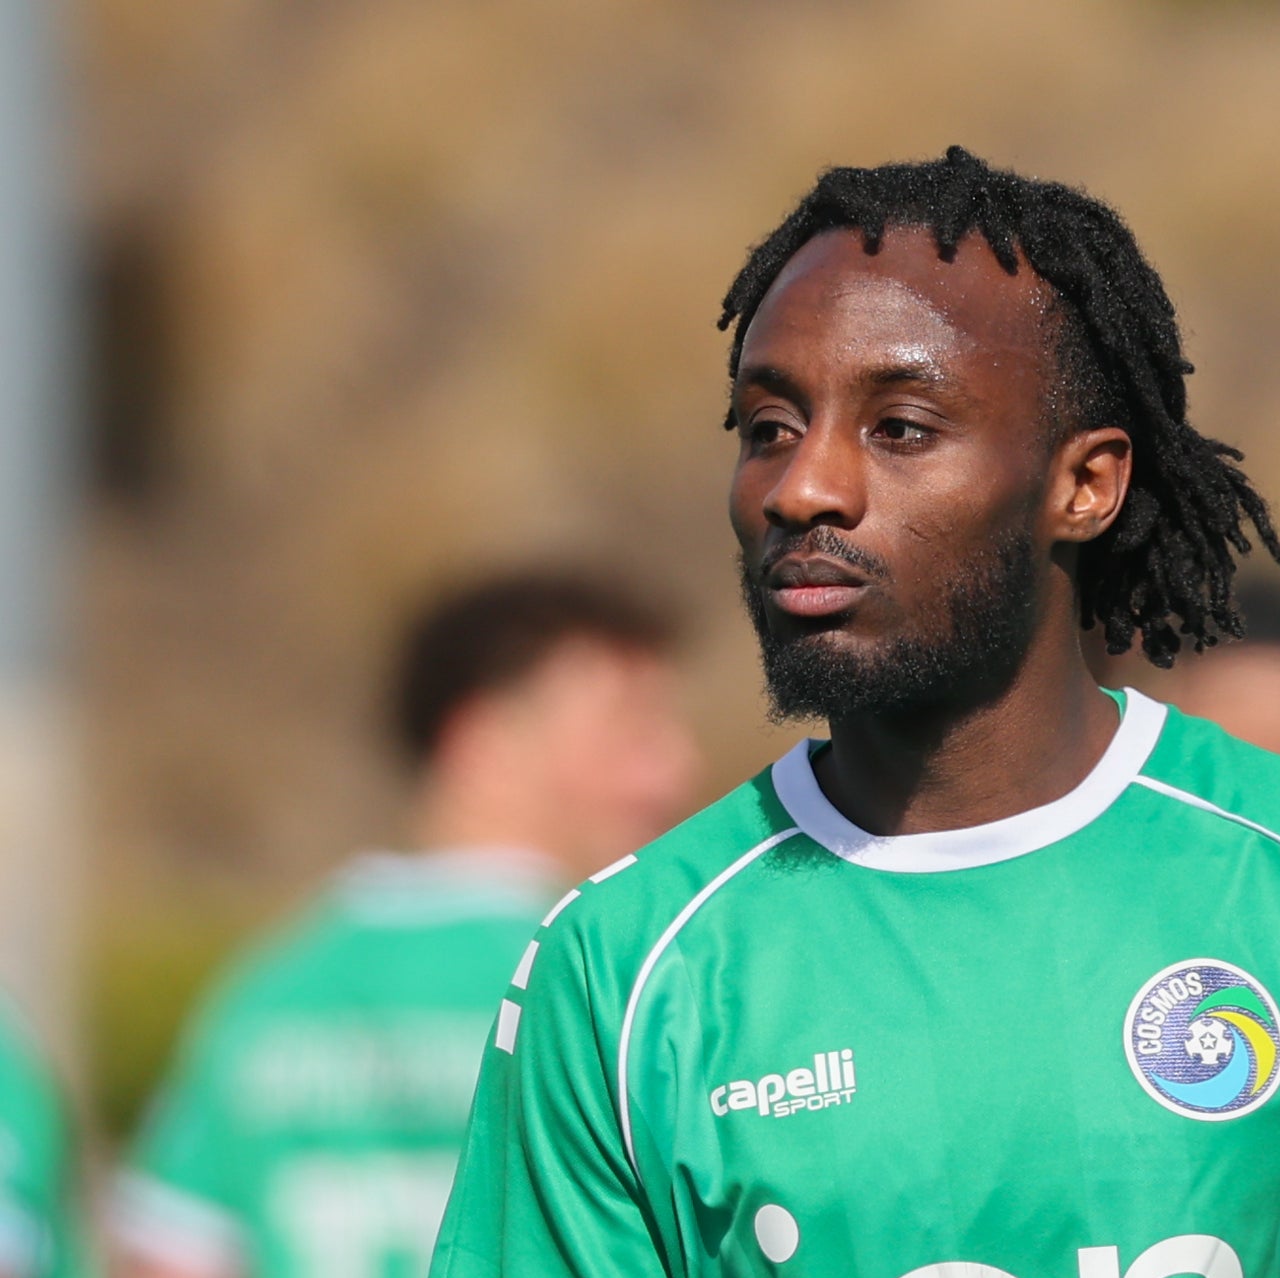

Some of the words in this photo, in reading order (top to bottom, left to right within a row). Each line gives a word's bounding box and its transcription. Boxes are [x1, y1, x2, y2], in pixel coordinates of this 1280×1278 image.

[1137, 971, 1204, 1056] COSMOS
[710, 1048, 856, 1117] capelli
[773, 1088, 857, 1118] SPORT
